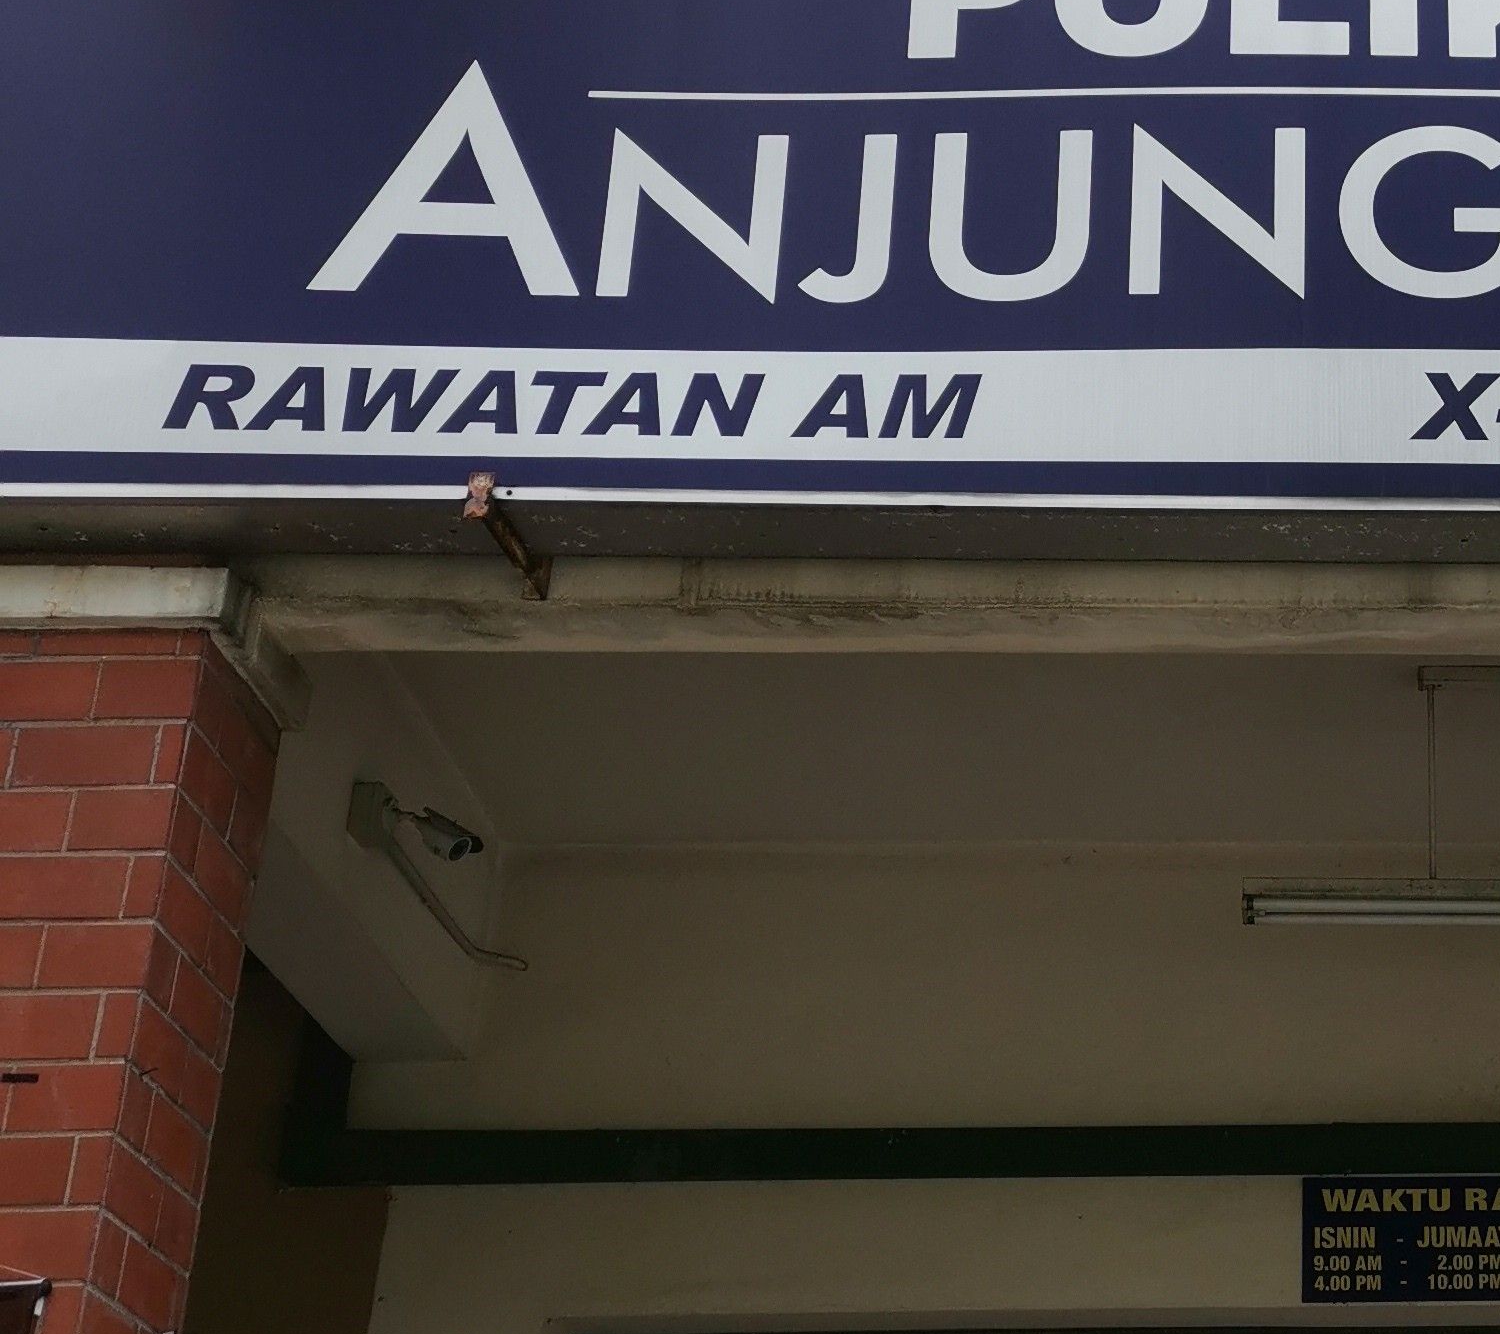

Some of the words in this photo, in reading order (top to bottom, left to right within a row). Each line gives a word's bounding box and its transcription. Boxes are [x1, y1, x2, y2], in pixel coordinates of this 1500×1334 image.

[162, 362, 765, 438] RAWATAN
[791, 372, 983, 440] AM
[1321, 1187, 1451, 1212] WAKTU
[1314, 1226, 1376, 1249] ISNIN
[1313, 1255, 1350, 1271] 9.00
[1354, 1255, 1382, 1271] AM
[1437, 1254, 1473, 1270] 2.00
[1314, 1275, 1350, 1291] 4.00
[1355, 1275, 1382, 1291] PM
[1427, 1274, 1474, 1290] 10.00
